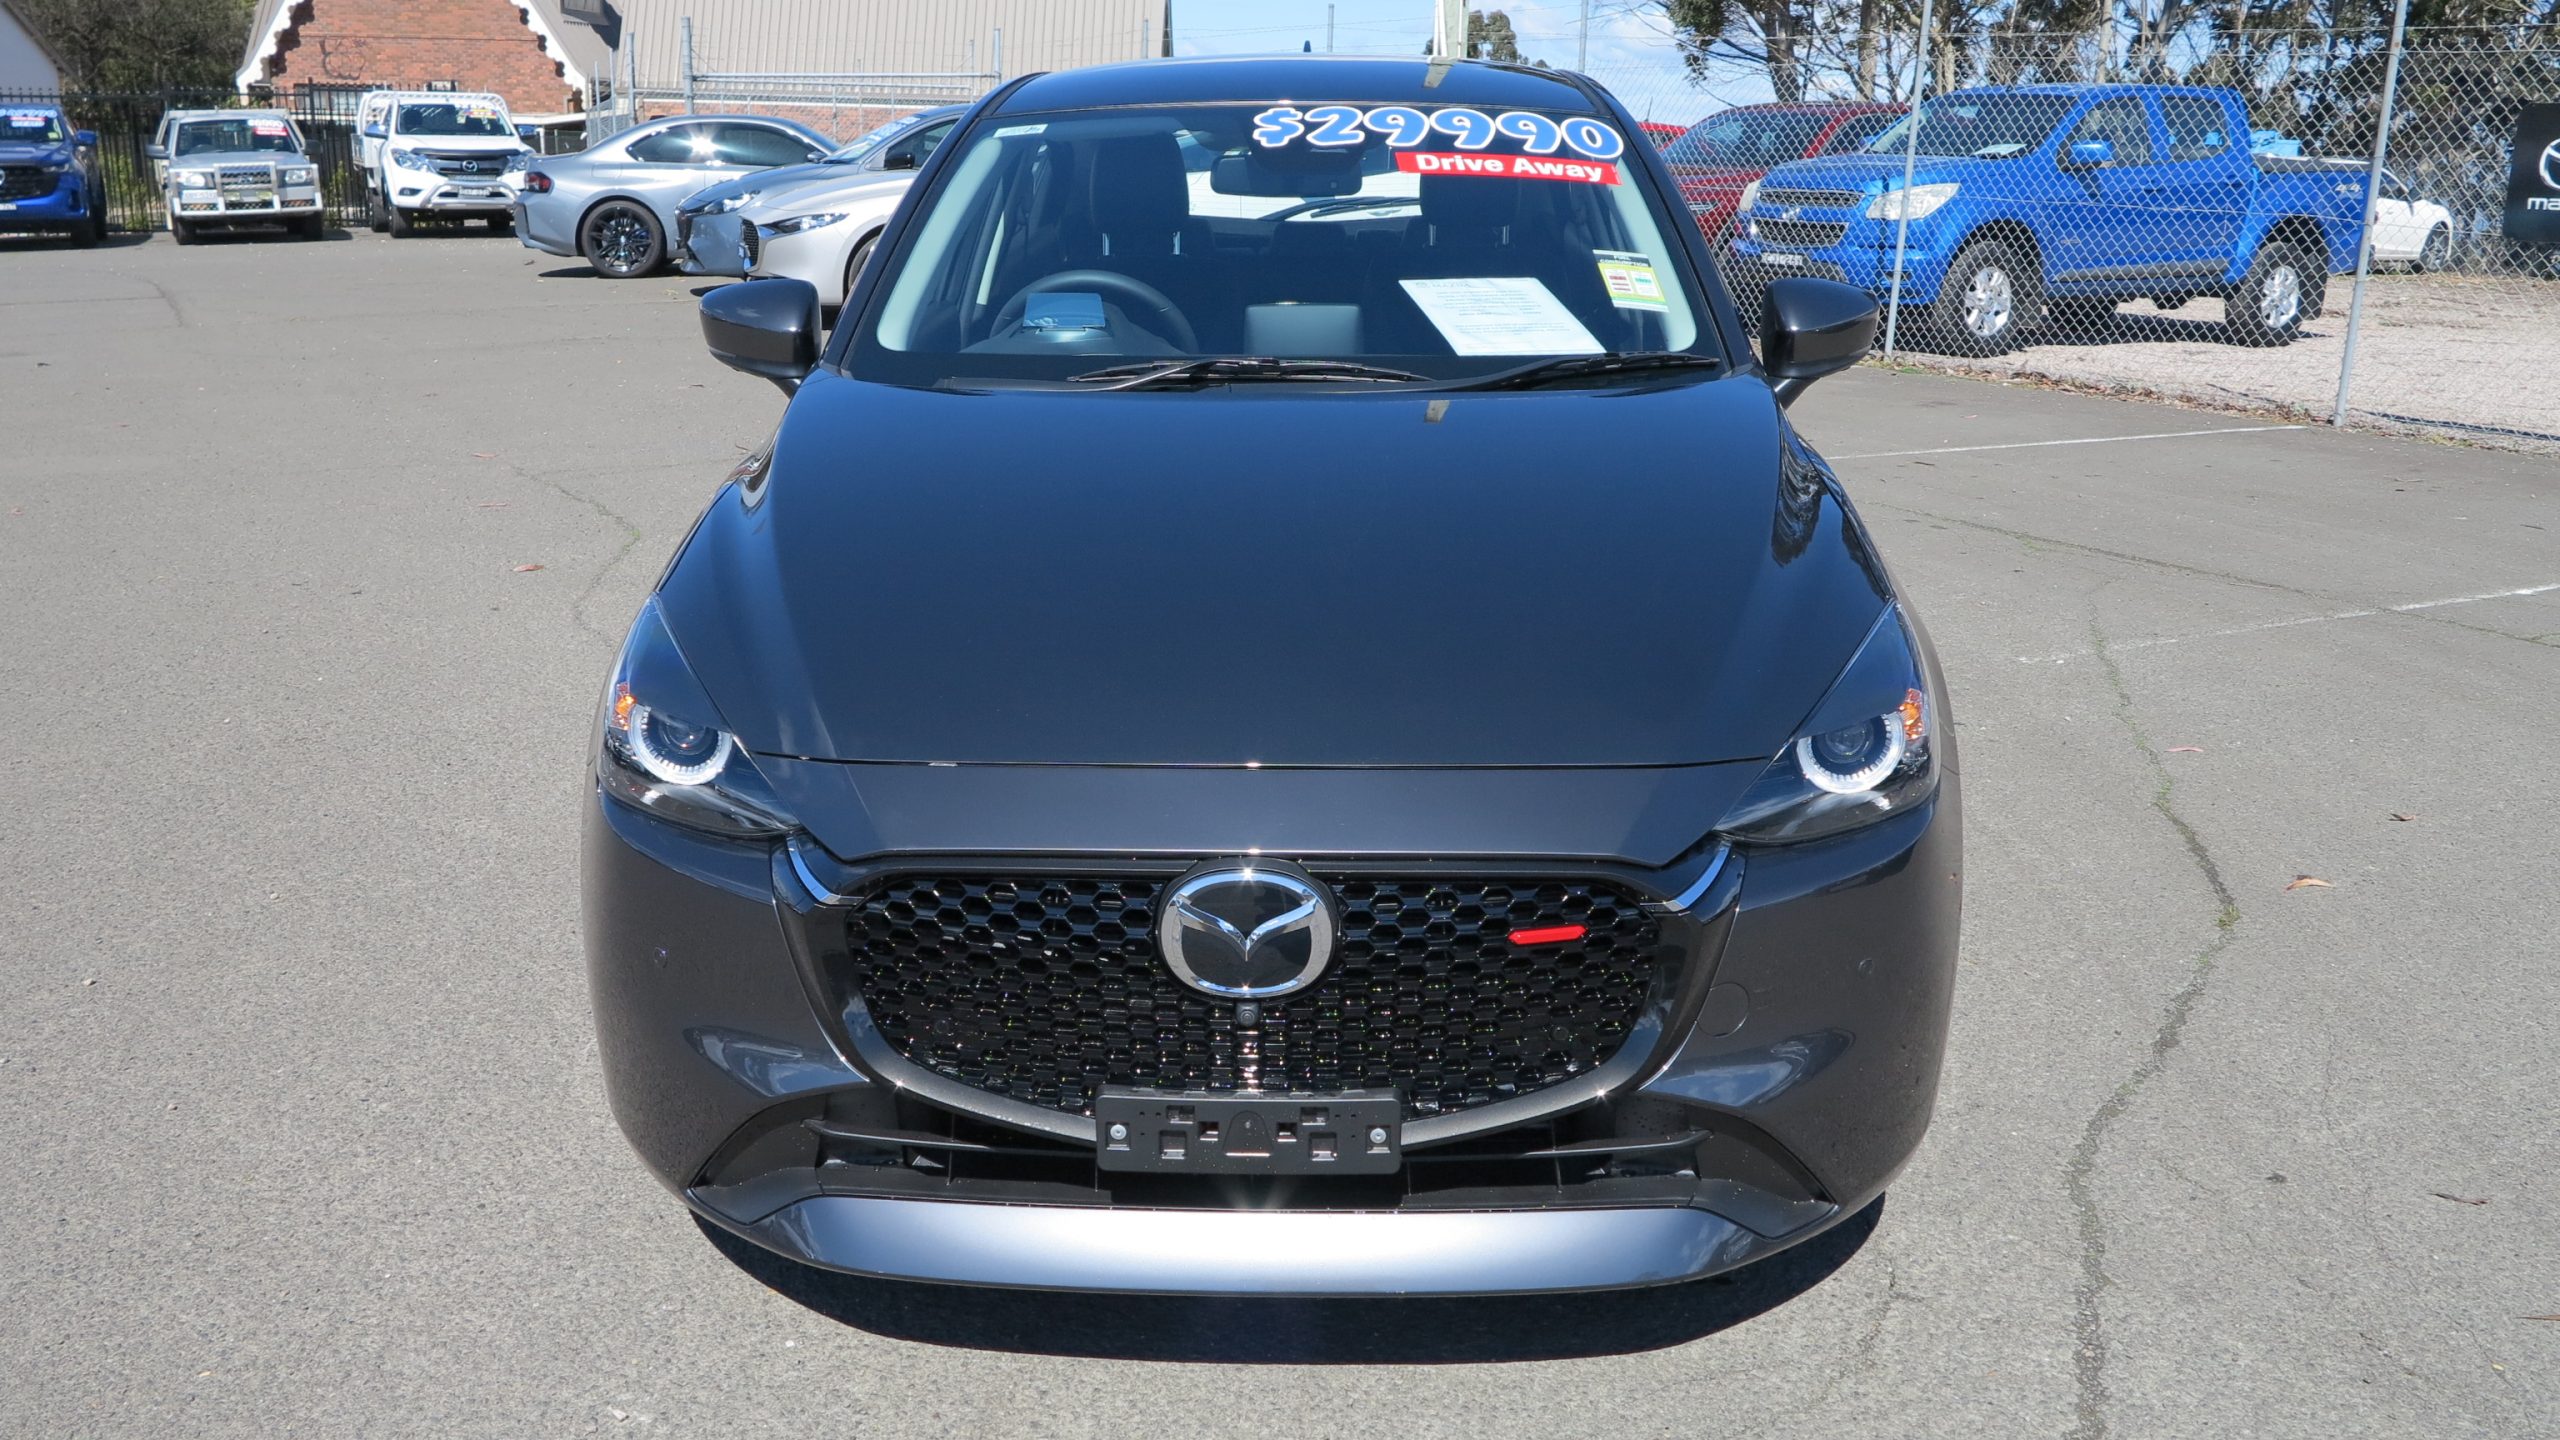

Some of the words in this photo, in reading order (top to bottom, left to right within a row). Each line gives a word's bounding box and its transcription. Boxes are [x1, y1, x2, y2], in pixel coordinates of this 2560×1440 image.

[1252, 106, 1625, 159] $29990
[1415, 153, 1504, 173] Drive
[1512, 157, 1604, 183] Away
